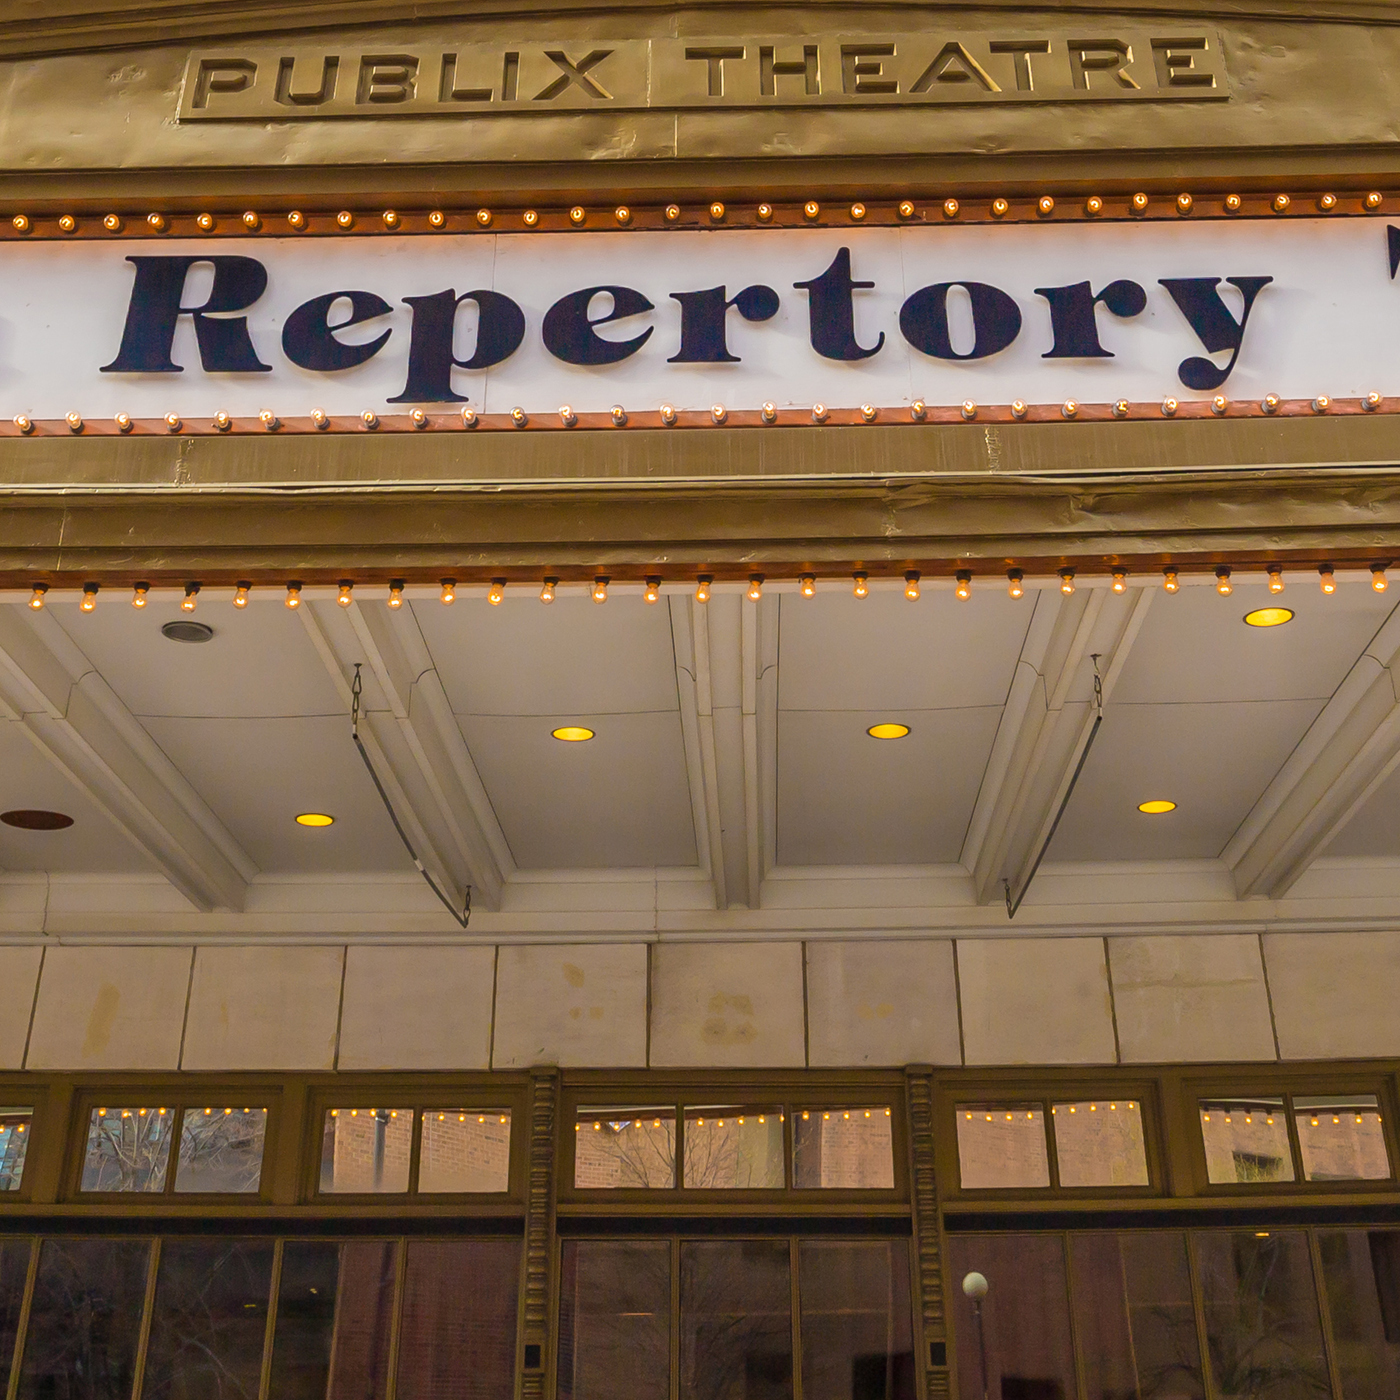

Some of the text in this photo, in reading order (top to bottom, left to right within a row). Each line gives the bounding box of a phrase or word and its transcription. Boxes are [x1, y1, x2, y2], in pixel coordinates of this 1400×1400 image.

[191, 36, 1217, 109] PUBLIX THEATRE
[98, 246, 1274, 404] Repertory
